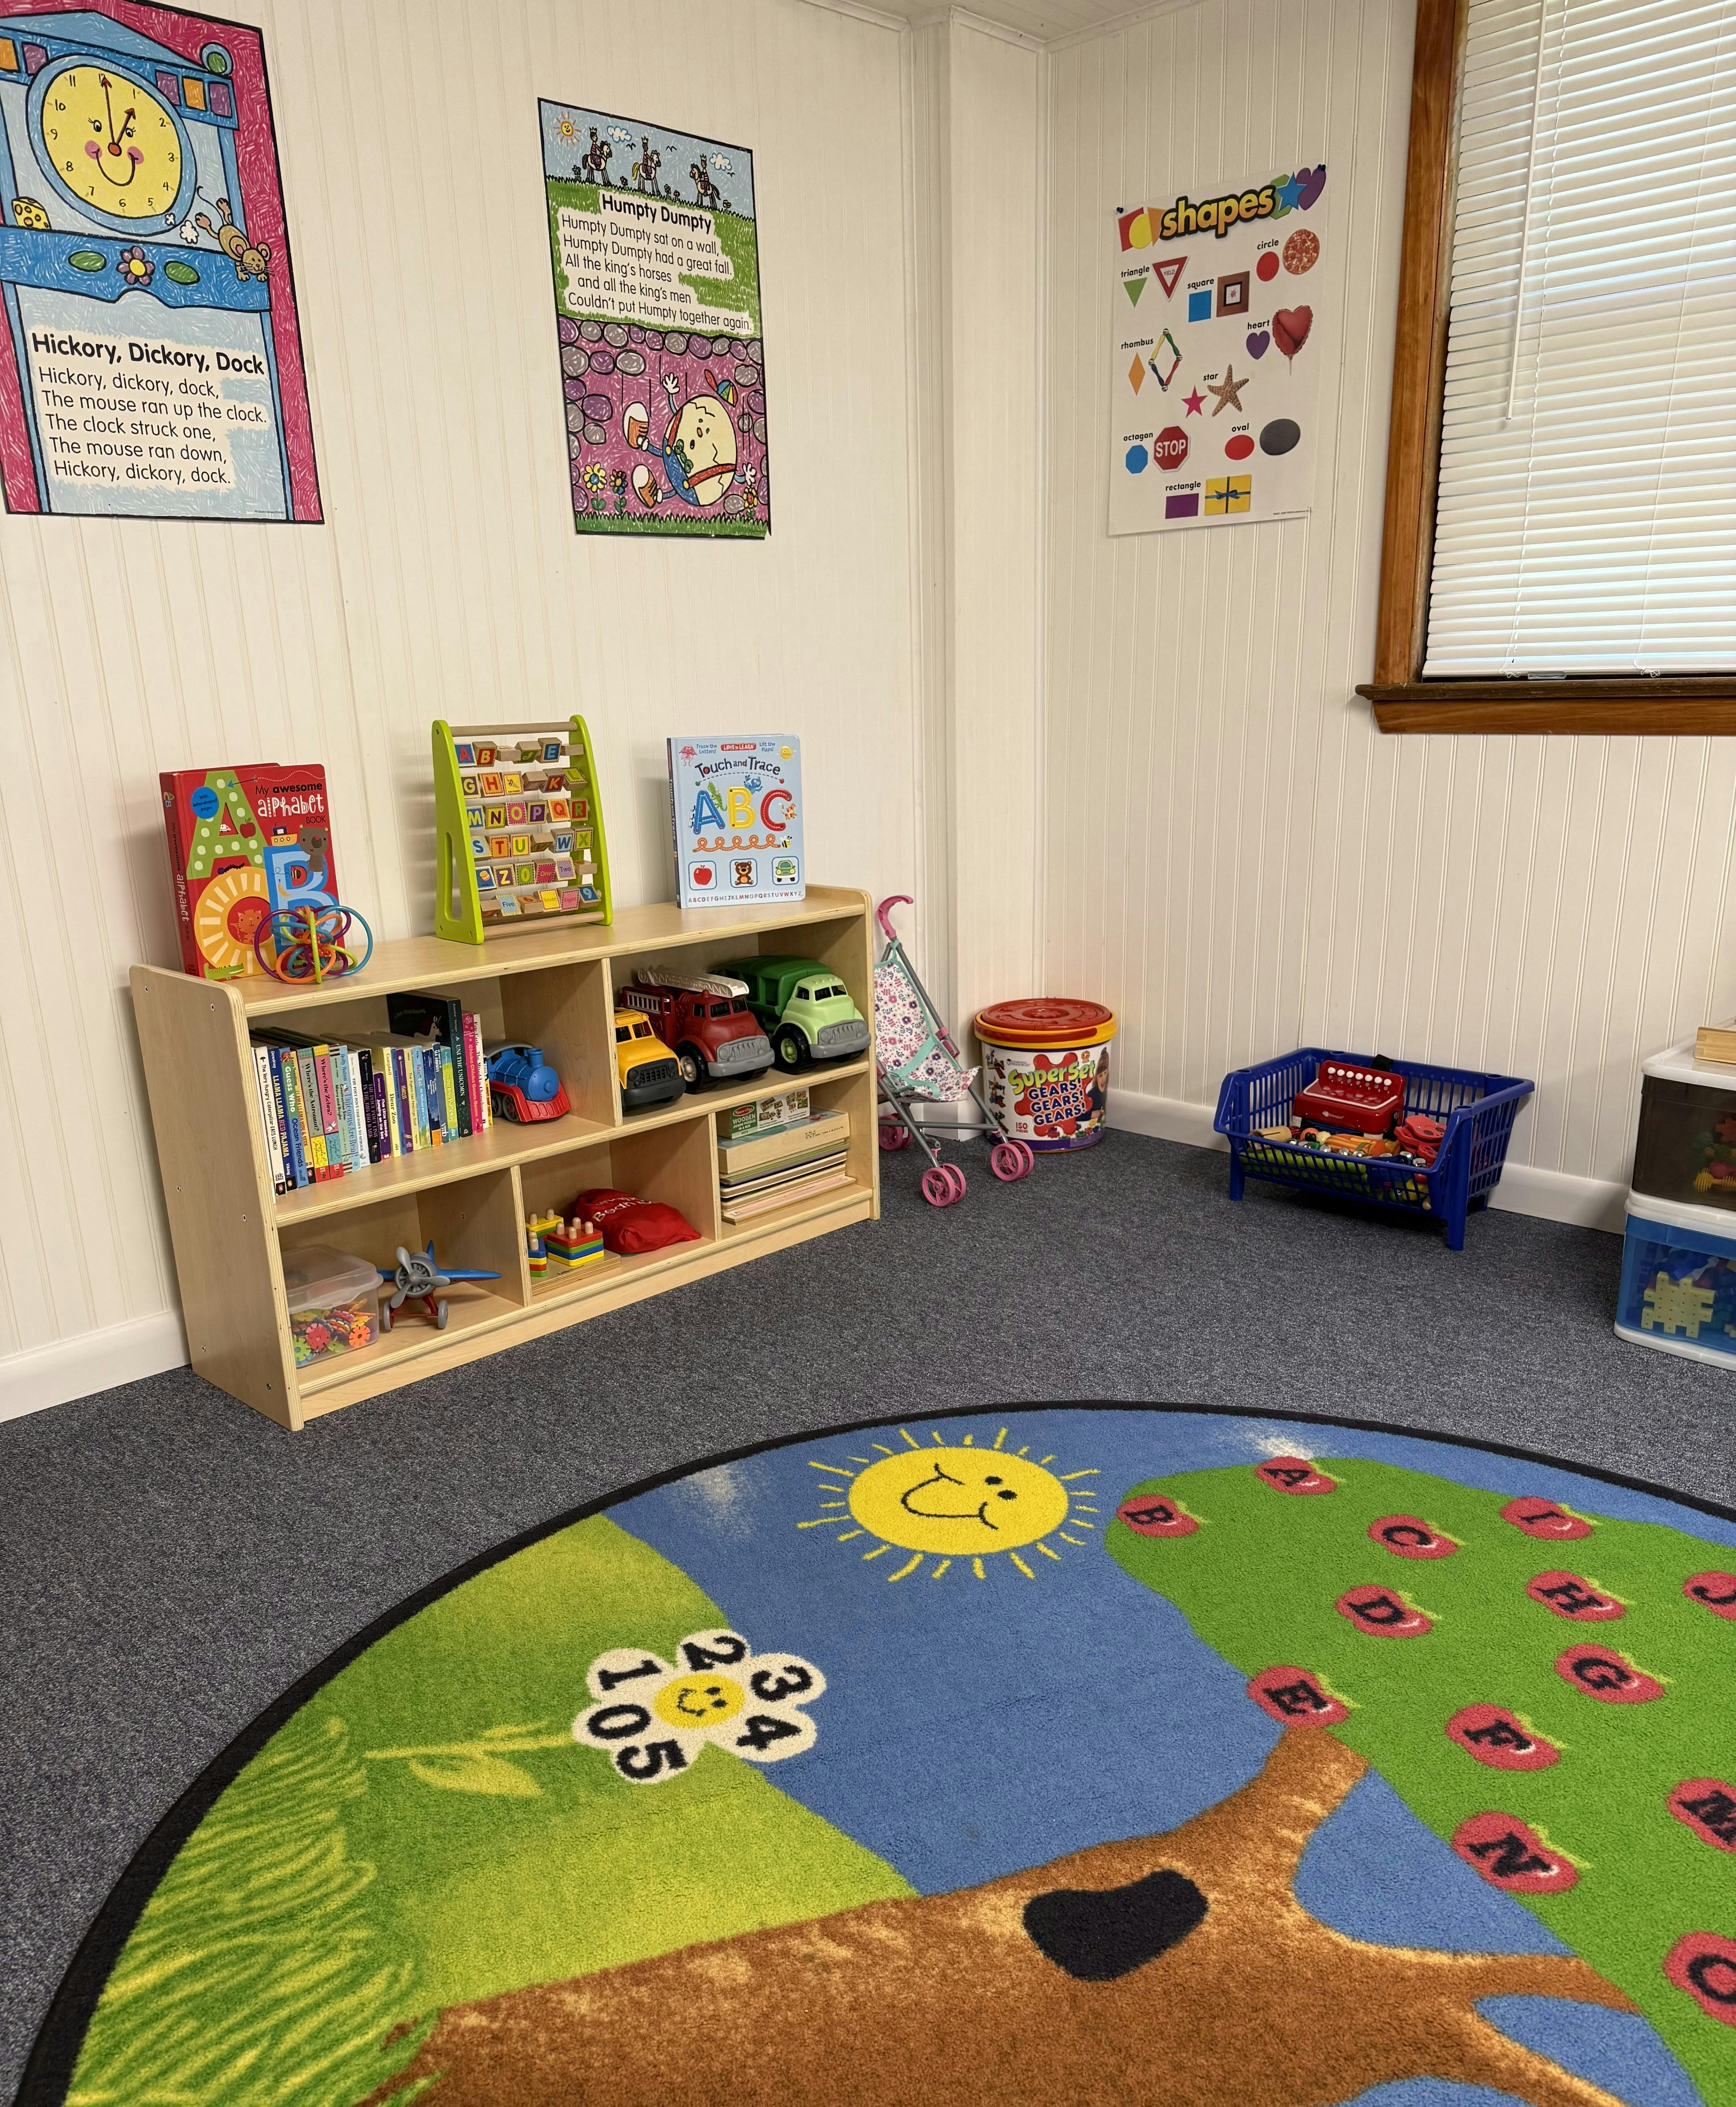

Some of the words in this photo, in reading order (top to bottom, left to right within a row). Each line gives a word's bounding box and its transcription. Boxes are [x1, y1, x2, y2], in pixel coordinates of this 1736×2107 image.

[69, 75, 76, 87] 11
[55, 101, 66, 111] 10
[51, 128, 58, 140] 9
[160, 118, 166, 128] 2
[66, 161, 74, 172] 8
[169, 152, 174, 162] 3
[88, 186, 94, 196] 7
[163, 182, 169, 191] 4
[119, 198, 126, 207] 6
[148, 197, 153, 206] 5
[1161, 186, 1276, 239] shapes
[602, 194, 656, 223] Humpty
[661, 206, 711, 234] Dumpty
[562, 214, 606, 236] Humpty
[611, 222, 650, 244] Dumpty
[654, 232, 668, 244] sat
[671, 237, 684, 248] on
[687, 241, 693, 250] a
[696, 240, 719, 256] wall,
[1257, 239, 1279, 250] circle
[564, 234, 608, 256] Humpty
[612, 241, 652, 263] Dumpty
[656, 248, 673, 265] had
[677, 258, 683, 267] a
[686, 259, 712, 273] great
[714, 260, 732, 275] fall.
[566, 254, 579, 267] All
[583, 256, 601, 270] the
[605, 261, 636, 278] king's
[639, 264, 671, 282] horses
[1121, 265, 1150, 278] triangle
[578, 275, 599, 289] and
[604, 278, 616, 291] all
[619, 280, 636, 294] the
[639, 282, 667, 301] king's
[670, 291, 691, 304] men
[1187, 278, 1214, 289] square
[569, 293, 615, 310] Couldn't
[619, 300, 635, 314] put
[639, 302, 677, 323] Humpty
[680, 307, 720, 326] together
[723, 317, 752, 331] again.
[1247, 319, 1270, 330] heart
[32, 332, 122, 363] Hickory,
[129, 343, 210, 372] Dickory,
[217, 352, 265, 374] Dock
[1121, 338, 1153, 349] rhombus
[39, 368, 107, 389] Hickory,
[113, 373, 173, 396] dickory,
[179, 380, 219, 399] dock,
[1203, 372, 1219, 381] star
[42, 390, 74, 407] The
[80, 397, 137, 412] mouse
[142, 401, 168, 415] ran
[174, 404, 193, 420] up
[198, 402, 222, 419] the
[227, 405, 267, 423] clock.
[46, 413, 77, 431] The
[83, 415, 126, 434] clock
[130, 420, 179, 438] struck
[183, 426, 216, 442] one,
[1123, 432, 1153, 442] octagon
[1231, 423, 1249, 432] oval
[49, 436, 81, 453] The
[86, 442, 143, 458] mouse
[149, 447, 175, 460] ran
[180, 446, 227, 464] down,
[1156, 439, 1186, 457] STOP
[54, 460, 120, 481] Hickory,
[126, 462, 186, 485] dickory,
[191, 466, 231, 484] dock.
[1165, 481, 1201, 491] rectangle
[481, 750, 490, 764] B
[548, 746, 557, 759] E
[695, 758, 732, 778] Touch
[748, 756, 780, 775] Trace
[255, 785, 269, 797] My
[273, 783, 322, 793] awesome
[464, 779, 475, 793] G
[486, 776, 499, 791] H
[258, 794, 324, 817] alphabet
[491, 811, 501, 824] N
[532, 806, 542, 820] P
[554, 802, 566, 816] Q
[575, 804, 583, 817] R
[472, 840, 484, 853] S
[496, 841, 504, 854] T
[515, 839, 526, 853] U
[558, 837, 571, 849] W
[579, 833, 588, 847] X
[499, 870, 510, 885] Z
[1008, 1060, 1095, 1095] SuperSet
[1028, 1078, 1082, 1100] GEARS!
[344, 1095, 353, 1126] Unicorns
[1031, 1091, 1083, 1113] GEARS!
[273, 1075, 281, 1097] LLAMA
[281, 1132, 289, 1157] PAJAMA
[310, 1100, 319, 1131] Astronaut?
[733, 1113, 755, 1124] WOODEN
[1033, 1102, 1086, 1126] GEARS!
[295, 1143, 304, 1167] Friends
[1263, 1468, 1311, 1487] A
[1123, 1504, 1174, 1525] B
[1382, 1526, 1432, 1547] C
[1535, 1581, 1606, 1613] H
[1347, 1595, 1406, 1625] D
[682, 1636, 747, 1671] 2
[598, 1660, 662, 1691] 1
[750, 1665, 812, 1702] 3
[1571, 1658, 1631, 1691] G
[1262, 1679, 1330, 1716] E
[588, 1703, 651, 1740] 0
[735, 1714, 802, 1751] 4
[1462, 1719, 1535, 1752] F
[616, 1738, 689, 1779] 5
[1464, 1832, 1553, 1878] N
